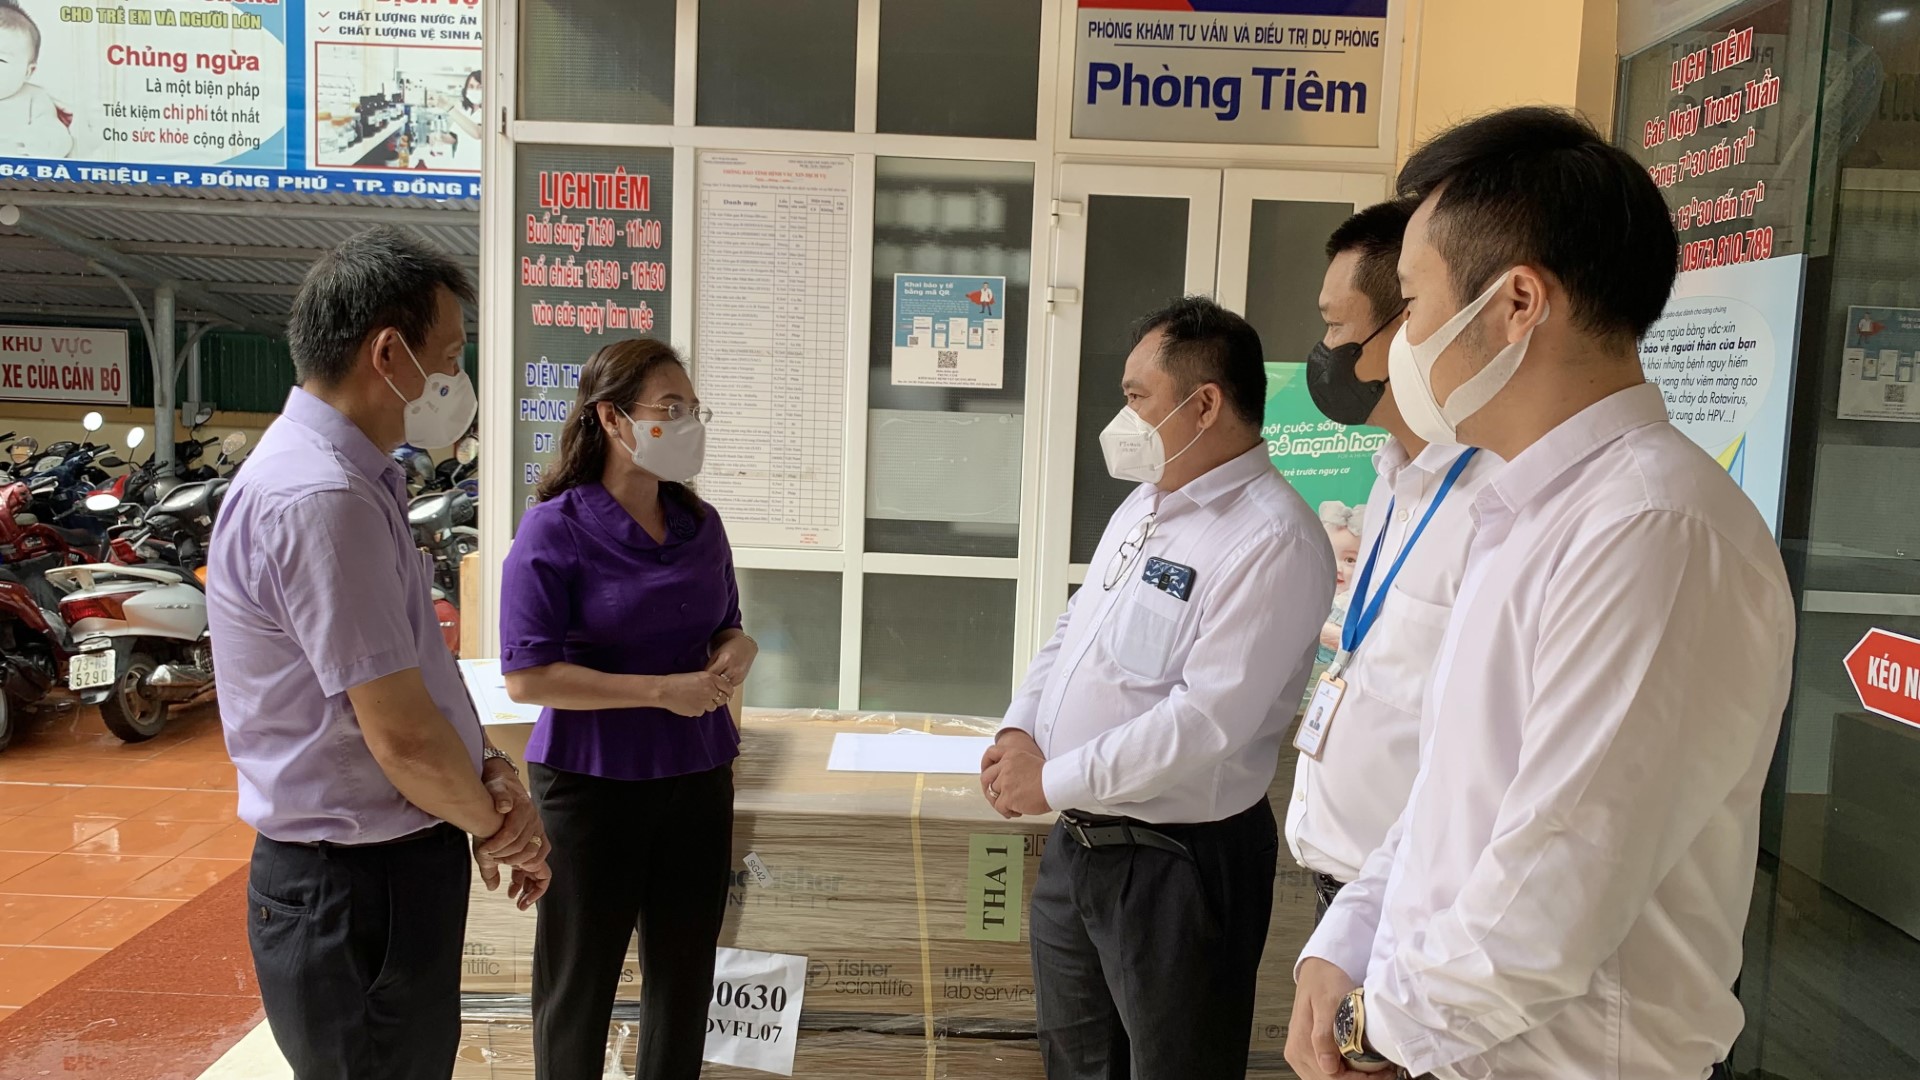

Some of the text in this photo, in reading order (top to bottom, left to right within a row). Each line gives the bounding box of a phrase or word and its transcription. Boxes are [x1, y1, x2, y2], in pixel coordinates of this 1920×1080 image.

[60, 5, 262, 30] CHO TRẺ EM VÀ NGƯỜI LỚN
[339, 9, 371, 21] CHẤT
[375, 12, 416, 25] LƯỢNG
[420, 13, 455, 25] NƯỚC
[339, 24, 470, 40] CHẤT LƯỢNG VỆ SINH
[1088, 17, 1132, 39] PHÒNG
[1136, 19, 1174, 41] KHÁM
[1179, 23, 1197, 42] TƯ
[1200, 18, 1228, 43] VẤN
[1234, 22, 1250, 43] VÀ
[1288, 28, 1308, 48] TRỊ
[1312, 28, 1332, 49] DỰ
[1335, 26, 1379, 48] PHÒNG
[107, 45, 260, 75] Chủng ngừa
[1671, 26, 1753, 94] LỊCH TIÊM
[146, 78, 260, 100] Là một biện pháp
[1087, 62, 1367, 121] Phòng Tiêm
[103, 101, 260, 124] Tiết kiệm chi phí tốt nhất
[1643, 67, 1780, 149] Các Ngày Trong Tuần
[103, 127, 260, 150] Cho sức khỏe cộng đồng
[1708, 137, 1731, 173] đến
[37, 164, 70, 179] BÀ
[77, 166, 148, 183] TRIỆU
[174, 171, 193, 184] P.
[278, 175, 328, 190] PHÚ
[353, 178, 386, 192] TP.
[540, 165, 650, 215] LỊCH TIÊM
[1714, 188, 1738, 223] đến
[527, 212, 552, 244] Buổi
[554, 215, 584, 252] sáng:
[586, 216, 615, 247] 7h30
[626, 218, 661, 249] 11h00
[1683, 226, 1773, 272] 0973.810.789
[522, 254, 547, 286] Buổi
[550, 255, 583, 288] chiều:
[586, 259, 620, 289] 13h30
[631, 261, 665, 292] 16h30
[532, 299, 653, 334] vào các ngày làm việc
[2, 336, 92, 358] KHU VỰC
[1661, 343, 1669, 355] vệ
[1697, 340, 1716, 351] thân
[1719, 338, 1735, 350] của
[1738, 337, 1756, 351] bạn
[526, 356, 559, 393] ĐIỆN
[1686, 355, 1705, 371] bệnh
[1706, 359, 1726, 372] nguy
[1728, 354, 1748, 368] hiểm
[2, 358, 121, 396] XE CỦA CÁN BỘ
[1662, 378, 1679, 389] vong
[1697, 374, 1713, 387] viêm
[1716, 374, 1739, 390] màng
[1741, 375, 1758, 386] não
[520, 393, 567, 422] PHÒNG
[1698, 390, 1708, 403] do
[1710, 391, 1748, 406] Rotavirus,
[1283, 421, 1314, 435] cuộc
[1676, 412, 1693, 424] cung
[1695, 407, 1705, 421] do
[534, 433, 556, 453] ĐT:
[1291, 432, 1348, 458] mạnh
[1296, 467, 1317, 477] trước
[1318, 468, 1339, 477] nguy
[76, 669, 108, 687] 5290
[1867, 653, 1901, 693] KÉO
[747, 859, 767, 882] SG42
[982, 866, 1008, 930] THA
[836, 959, 892, 978] fisher
[944, 963, 994, 984] unity
[713, 981, 787, 1013] 0630
[835, 978, 913, 998] scientific
[944, 982, 1036, 1002] lab servic
